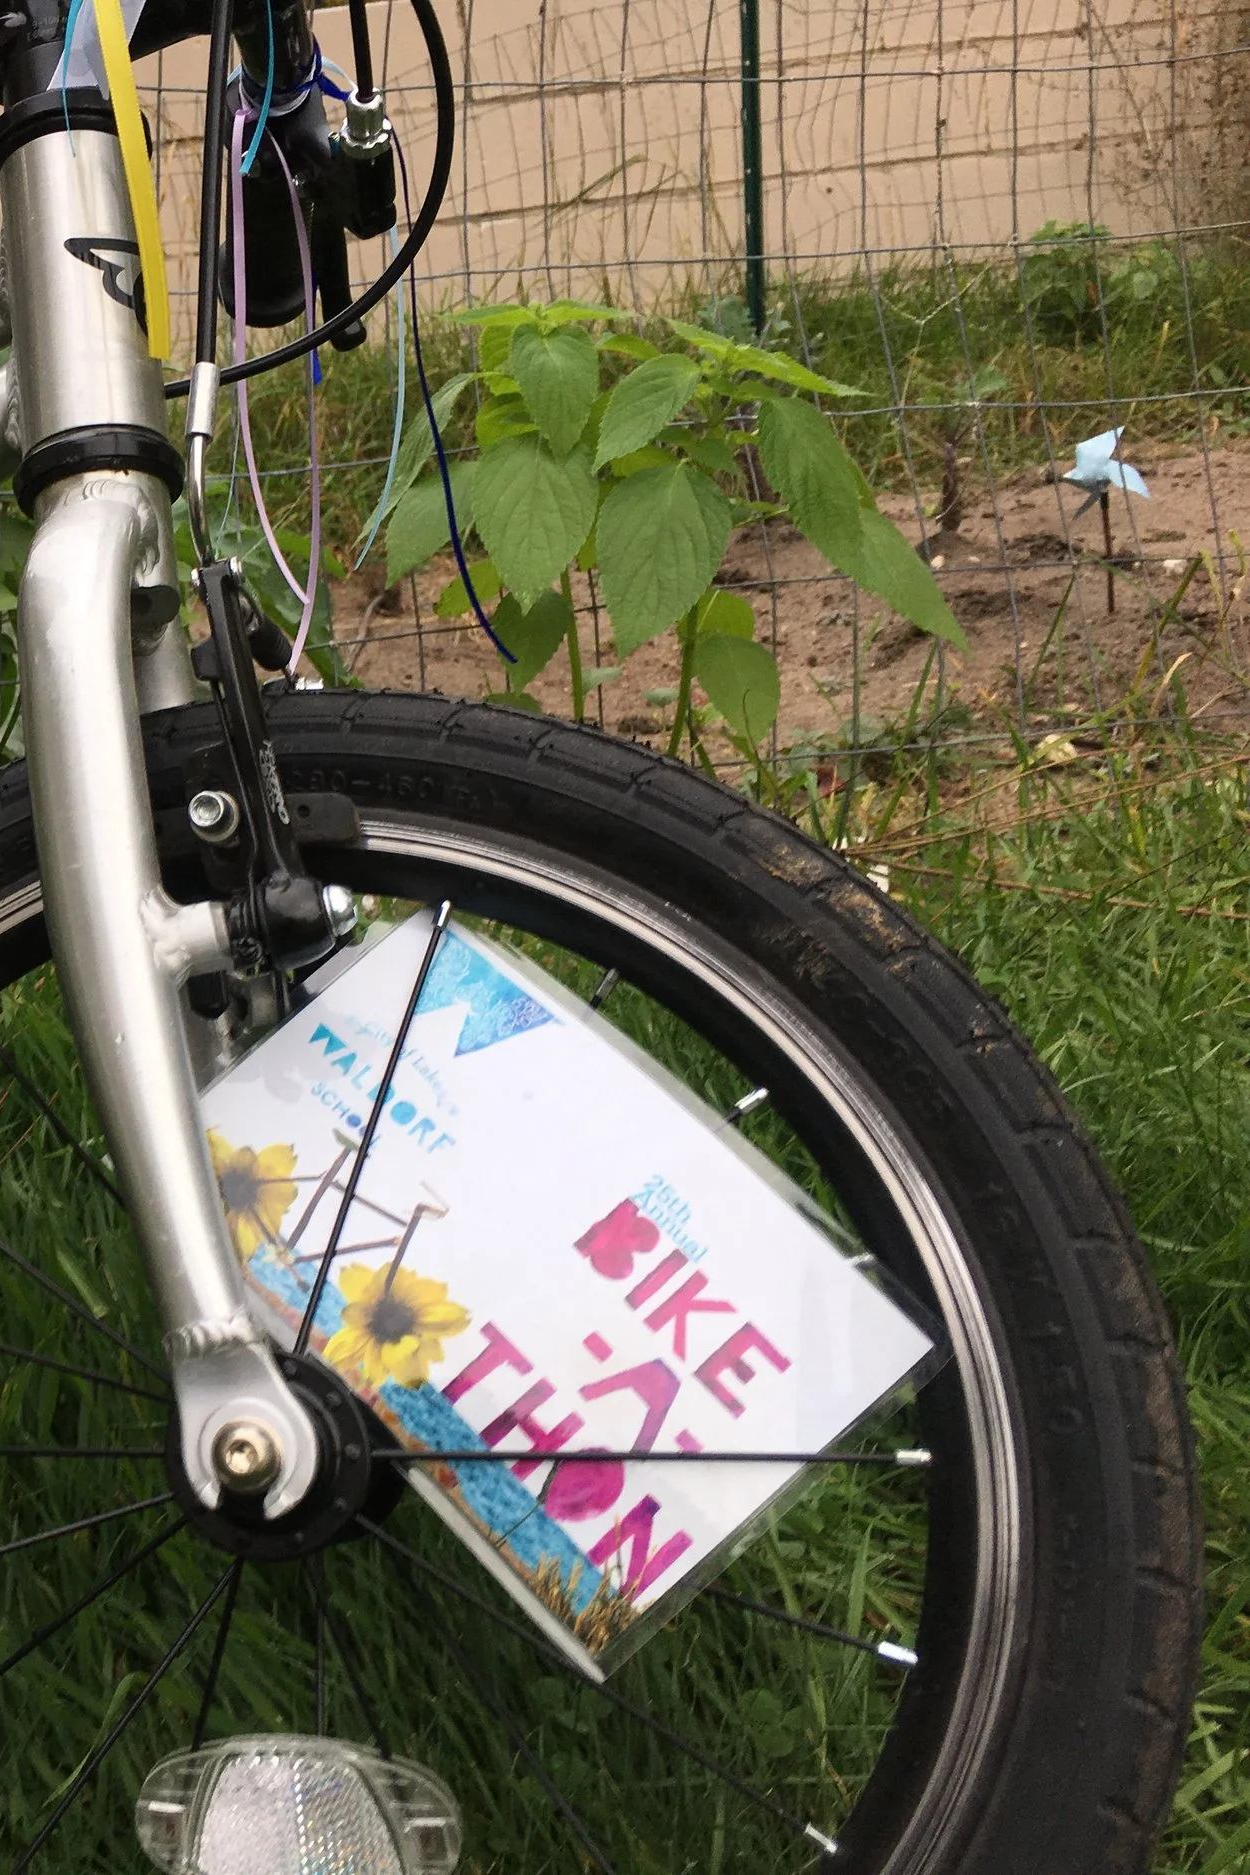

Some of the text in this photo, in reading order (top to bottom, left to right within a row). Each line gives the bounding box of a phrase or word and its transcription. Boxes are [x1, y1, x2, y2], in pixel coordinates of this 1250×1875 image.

[308, 1022, 457, 1153] WALDORF
[631, 1190, 709, 1264] Annual
[643, 1174, 691, 1225] 25th
[572, 1197, 793, 1420] BIKE
[441, 1320, 695, 1607] THON
